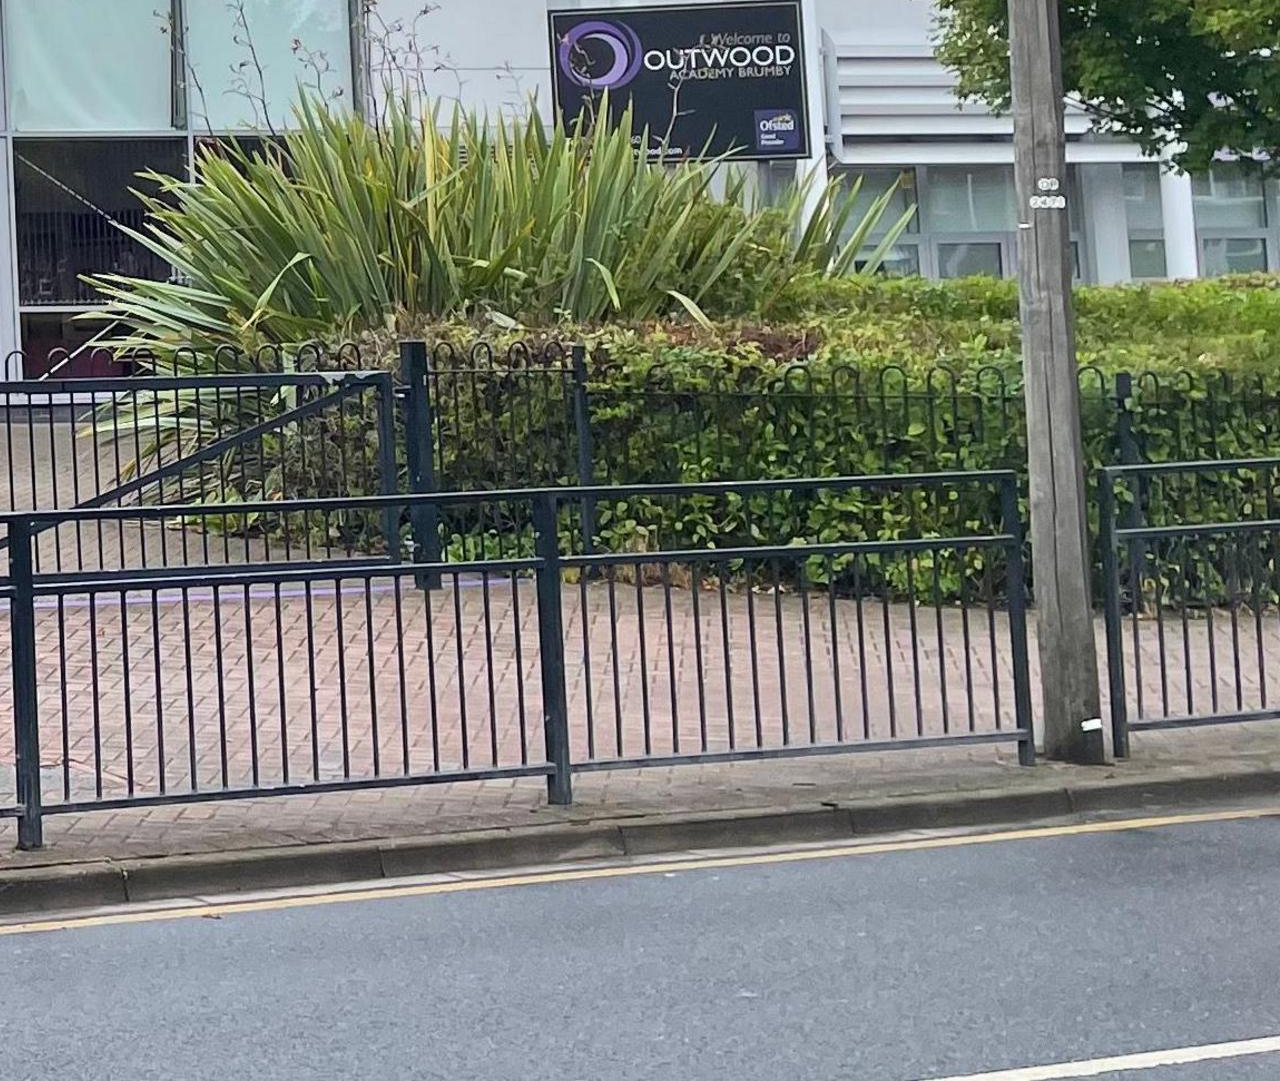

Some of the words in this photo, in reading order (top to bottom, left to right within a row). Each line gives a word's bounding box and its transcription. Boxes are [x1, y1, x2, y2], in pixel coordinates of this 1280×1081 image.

[713, 33, 773, 46] Welcome
[778, 32, 791, 44] to
[643, 45, 796, 71] OUTWOOD
[670, 67, 734, 80] ACADEMY
[738, 65, 792, 79] BRUMBY
[759, 119, 794, 131] Ofsted
